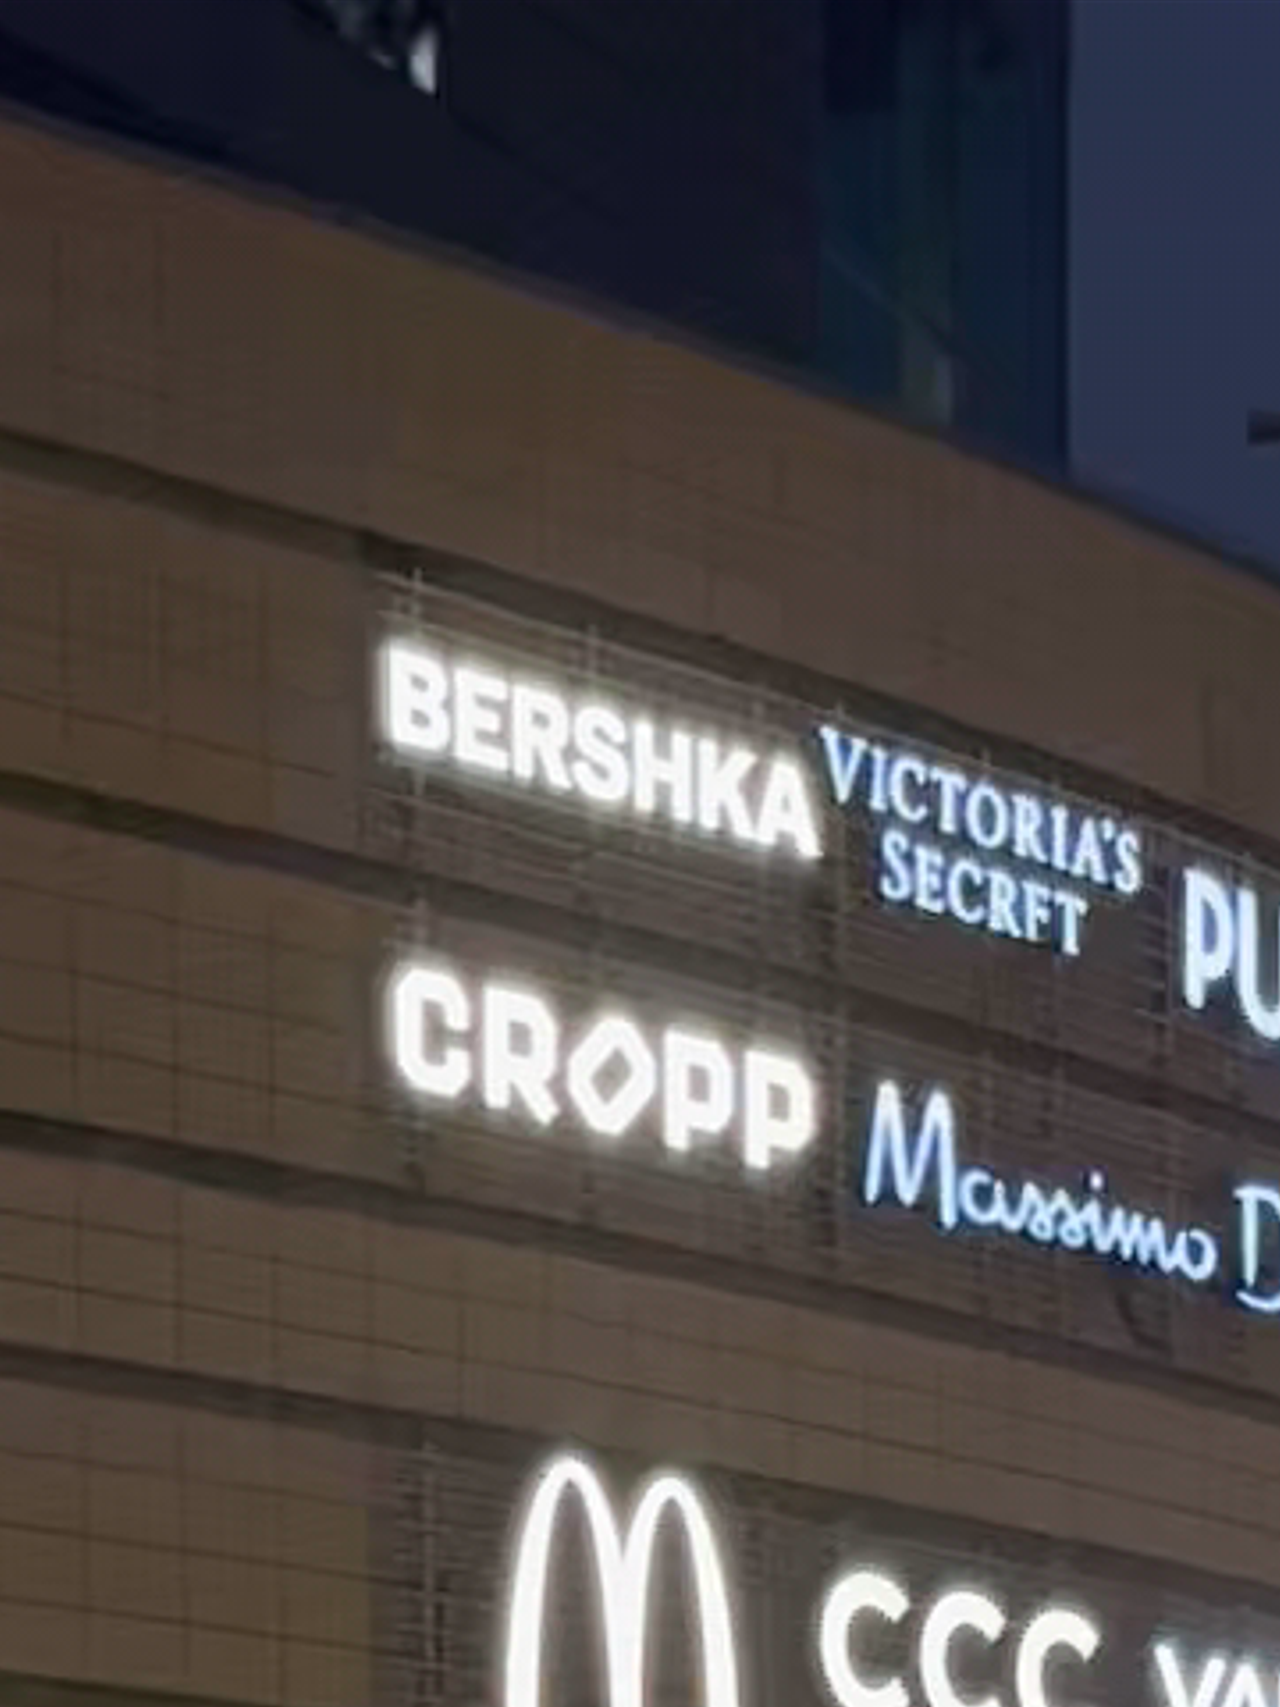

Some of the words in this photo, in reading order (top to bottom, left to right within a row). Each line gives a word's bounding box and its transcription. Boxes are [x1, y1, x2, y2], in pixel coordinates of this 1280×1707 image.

[383, 642, 821, 860] BERSHKA
[816, 724, 1141, 895] VICTORIA'S
[392, 963, 816, 1171] CROPP
[865, 1081, 1218, 1283] Massimo
